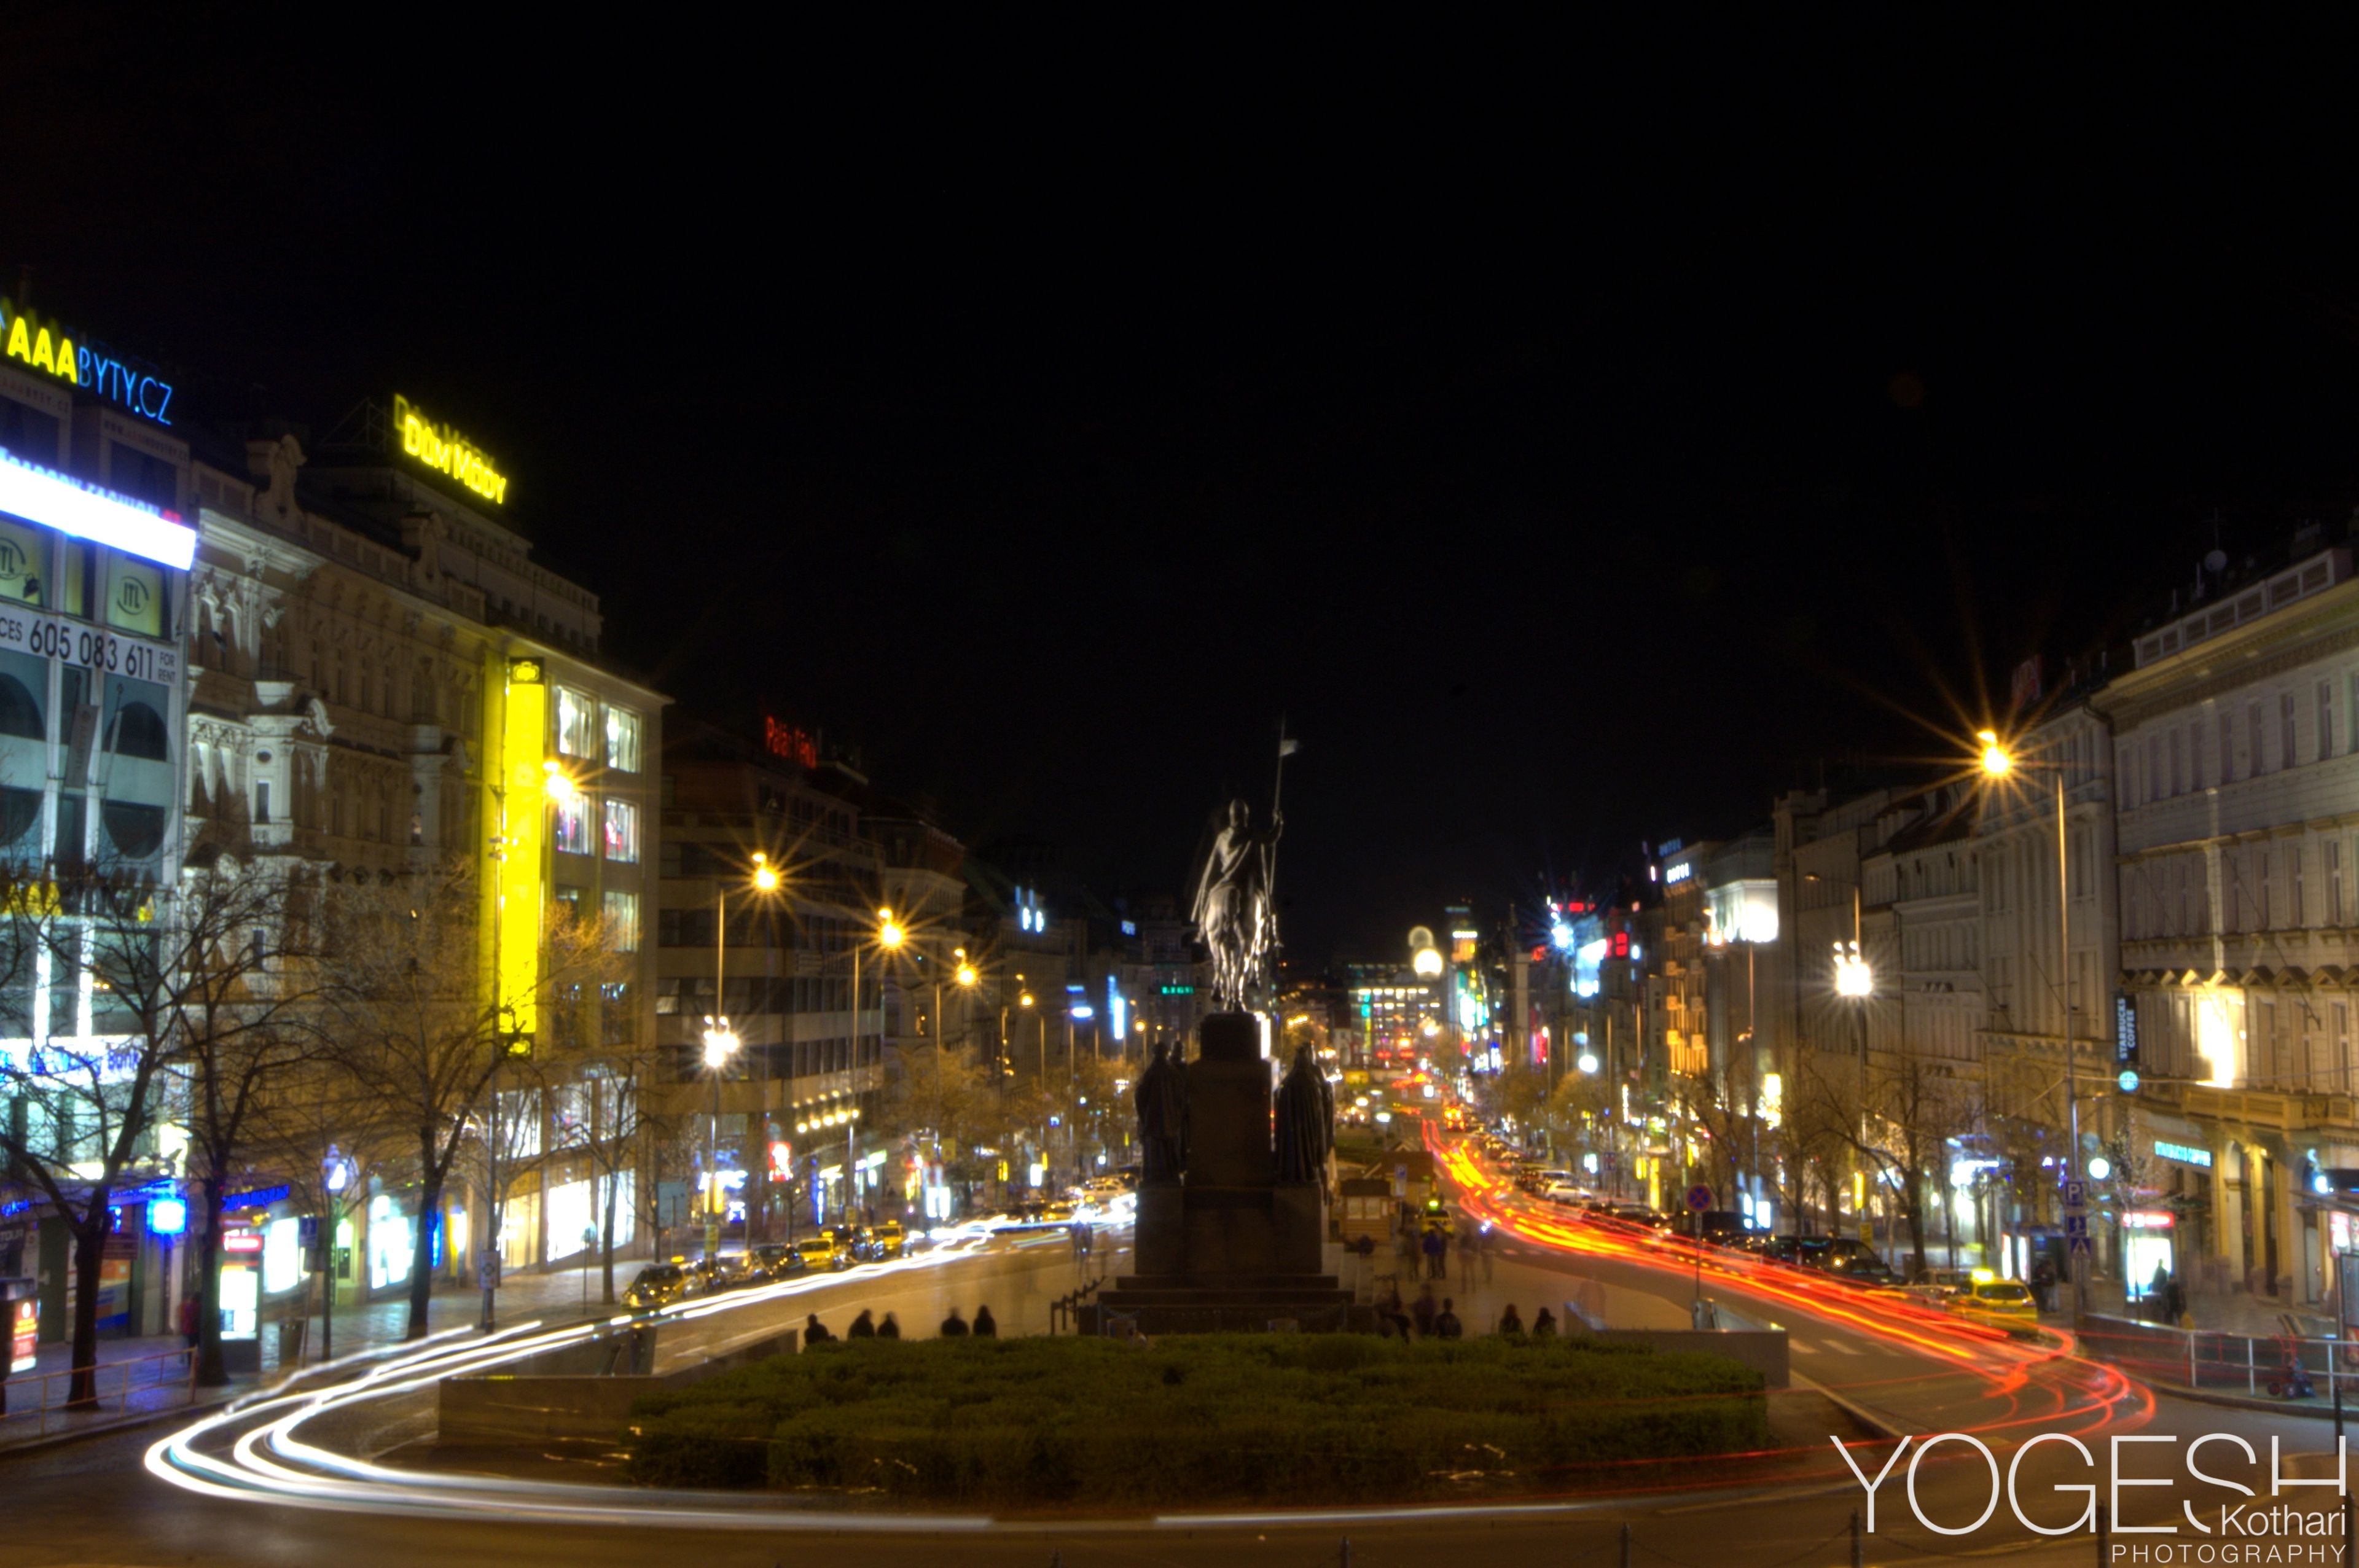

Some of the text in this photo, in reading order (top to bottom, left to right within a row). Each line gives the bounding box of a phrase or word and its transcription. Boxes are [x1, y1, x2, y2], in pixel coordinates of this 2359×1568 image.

[30, 620, 71, 660] 605
[80, 631, 117, 671] 083
[126, 644, 153, 681] 611
[160, 651, 175, 667] FOR
[158, 669, 176, 684] RENT
[2117, 998, 2128, 1059] STARBUCKS
[2126, 1009, 2135, 1048] COFFEE
[2068, 1183, 2081, 1201] P
